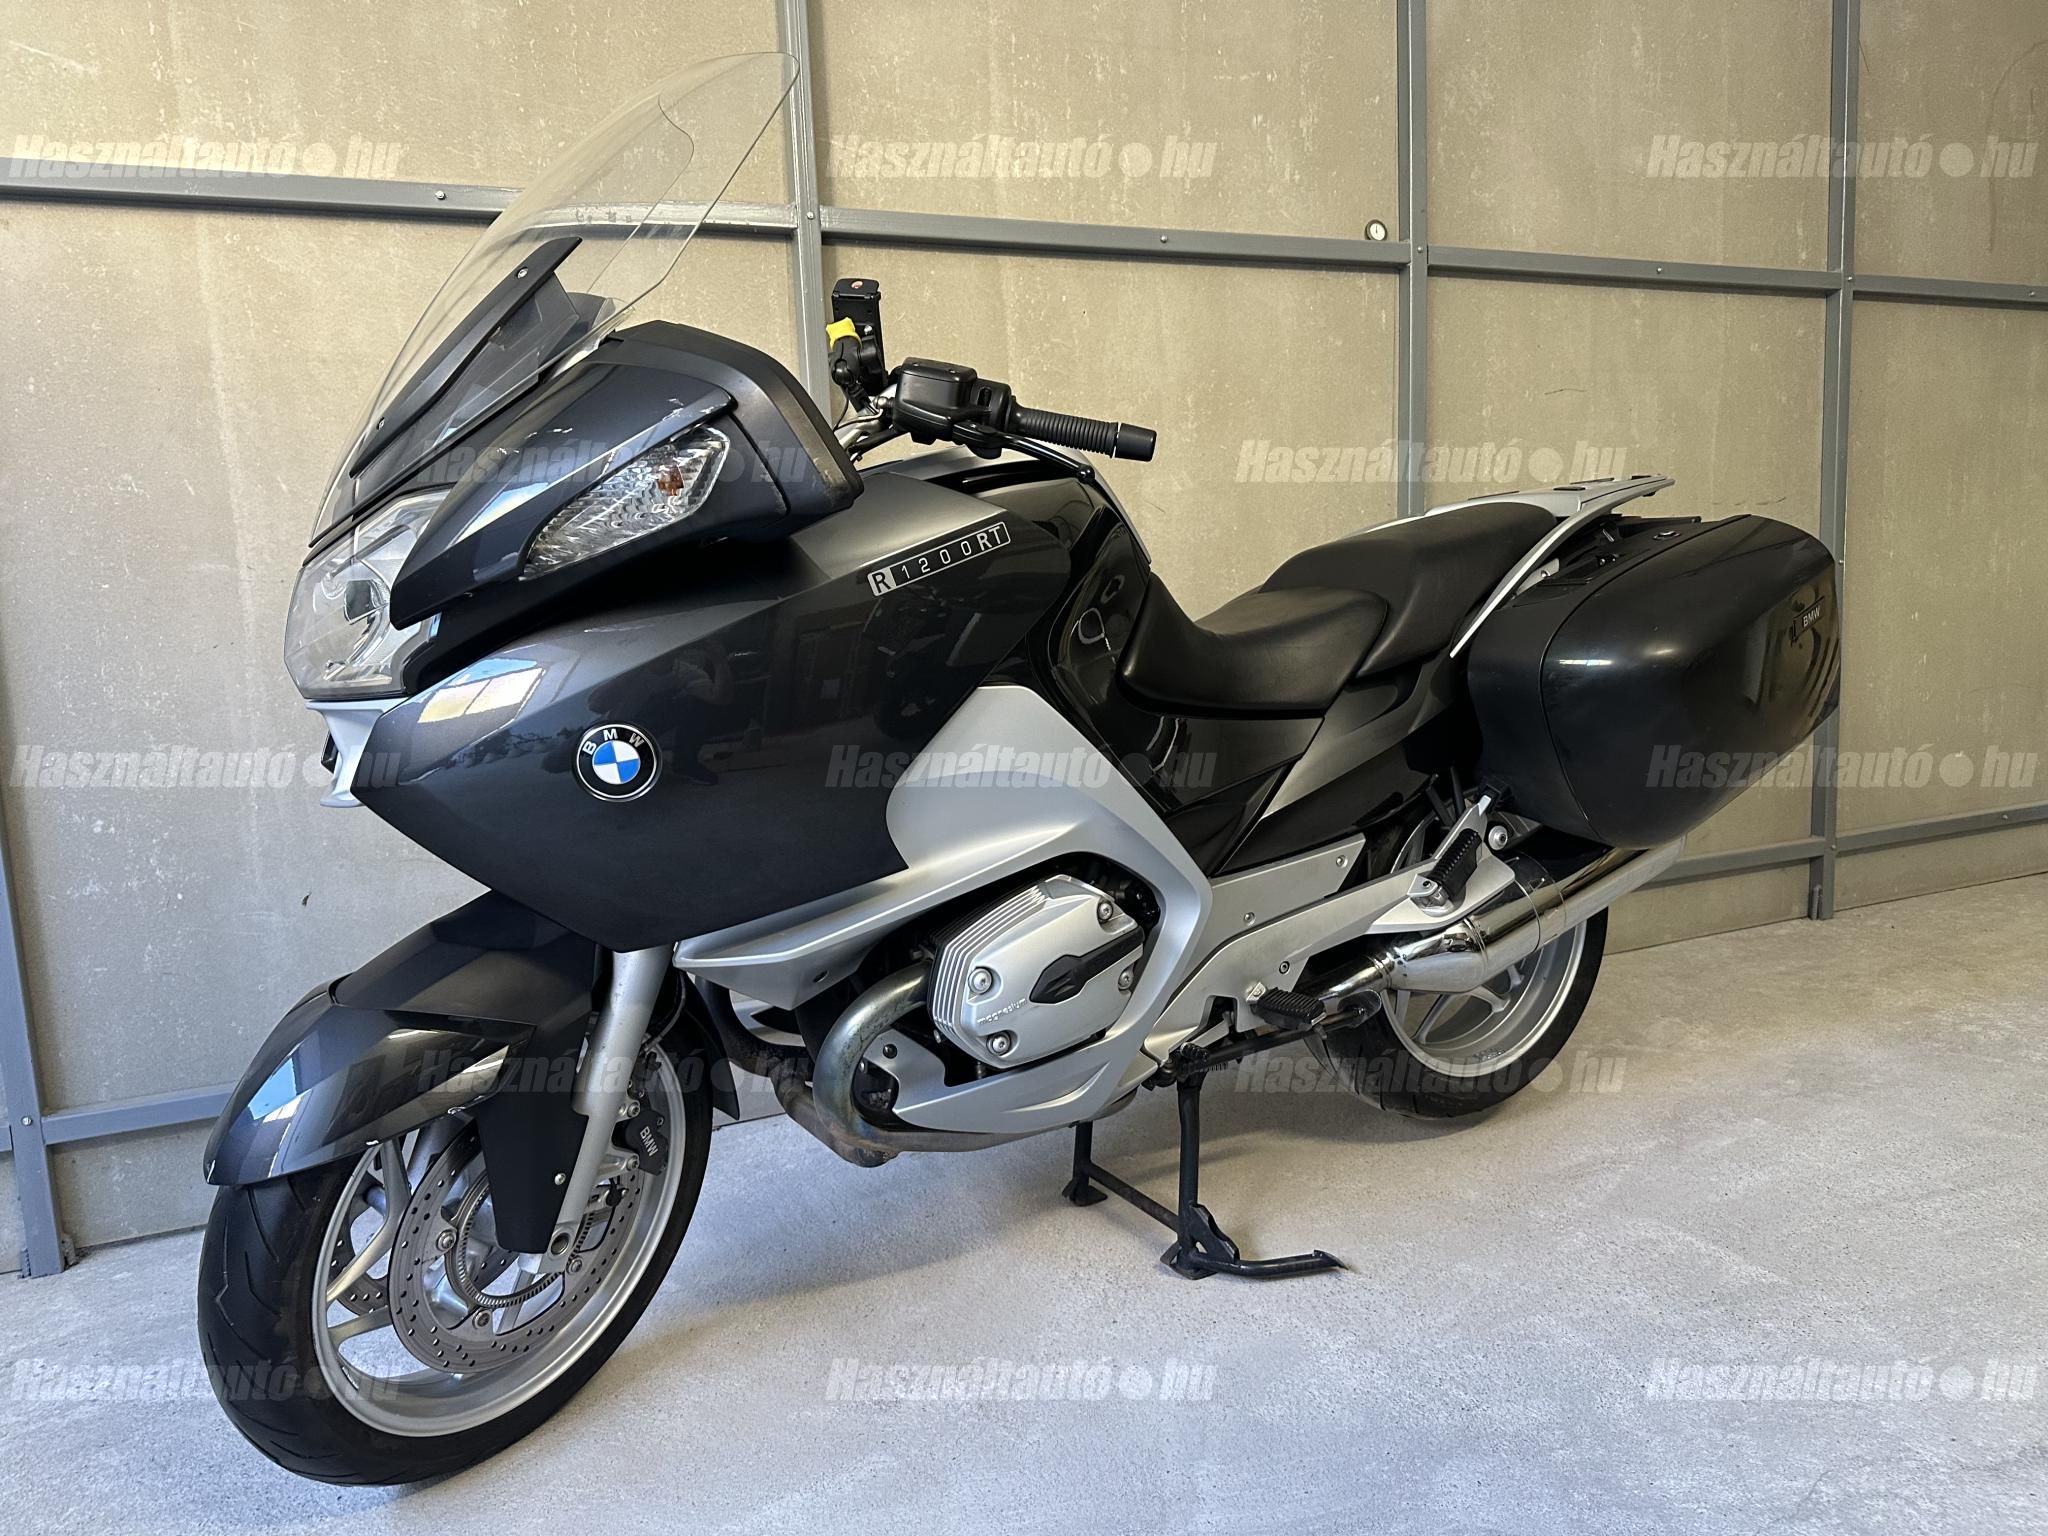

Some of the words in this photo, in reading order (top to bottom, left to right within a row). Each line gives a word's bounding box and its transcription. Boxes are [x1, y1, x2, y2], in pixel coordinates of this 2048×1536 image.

[1803, 604, 1820, 628] BMW
[582, 728, 645, 756] BMW
[640, 1126, 659, 1157] BMW
